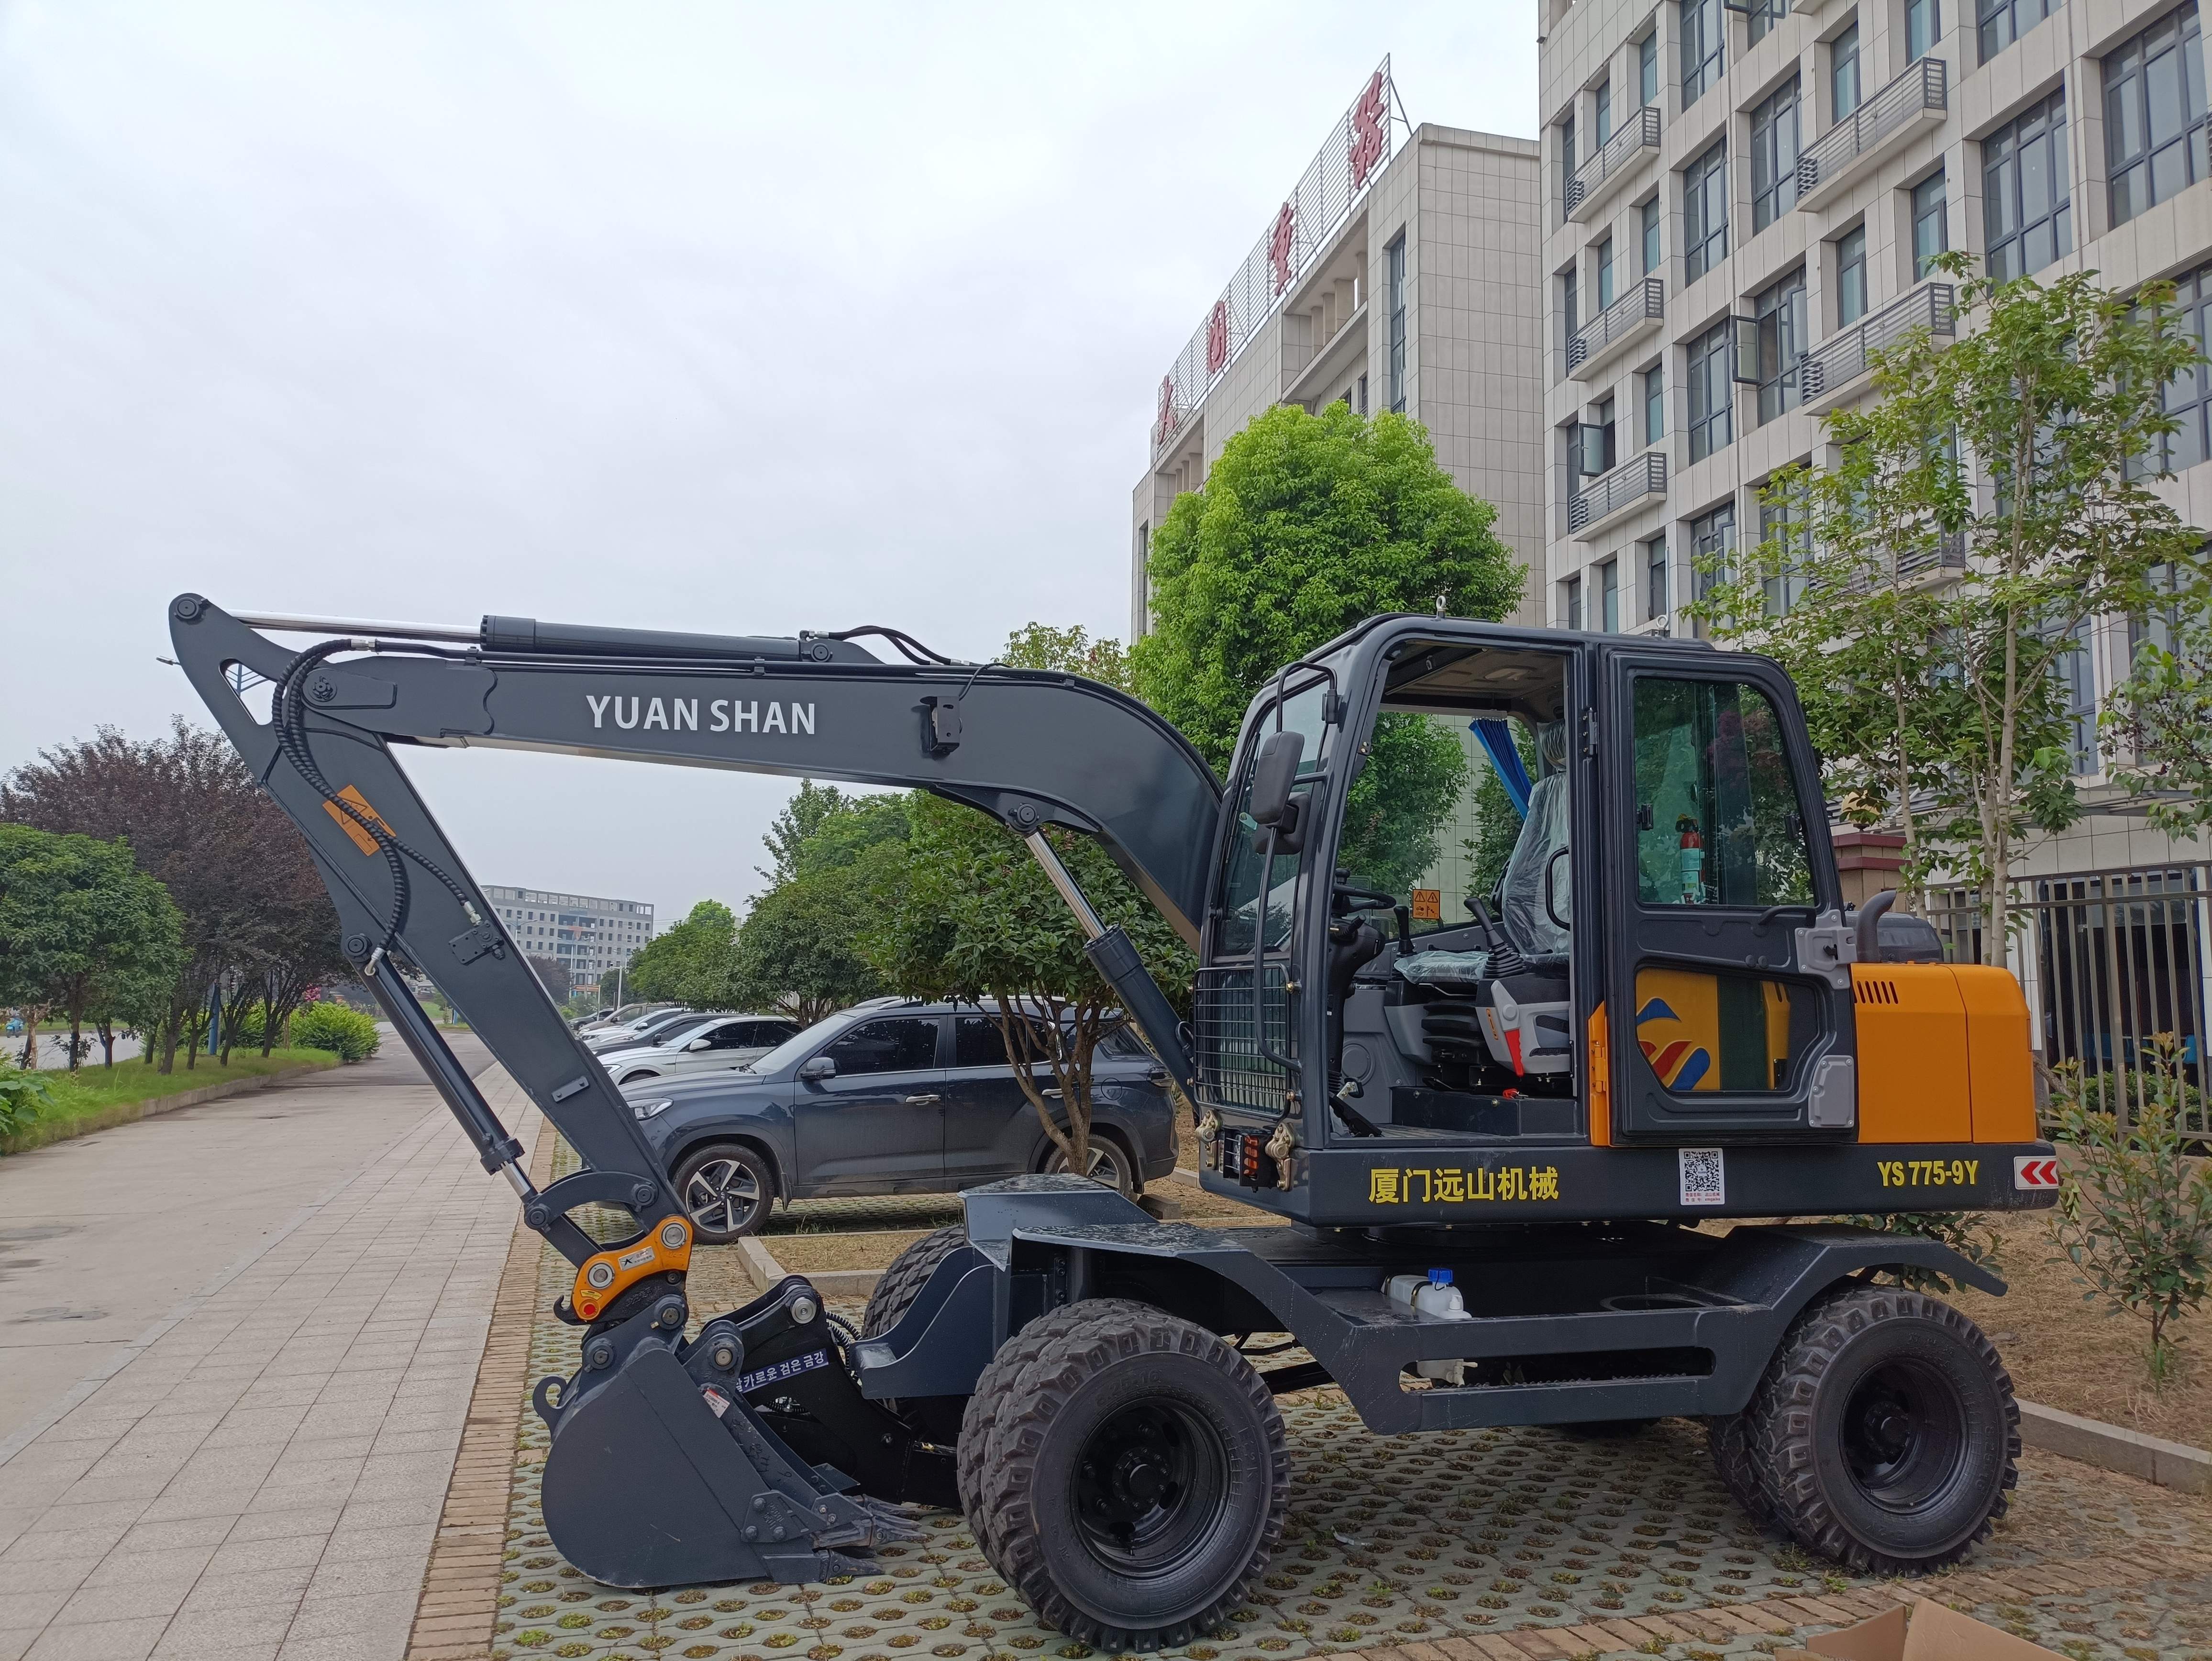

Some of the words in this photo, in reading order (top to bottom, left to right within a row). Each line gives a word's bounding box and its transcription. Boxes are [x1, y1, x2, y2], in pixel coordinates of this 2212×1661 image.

[586, 695, 698, 731] YUAN
[710, 699, 815, 735] SHAN
[1369, 1166, 1559, 1204] 厦门远山机械
[780, 1359, 802, 1376] 검은
[803, 1351, 824, 1368] 금강
